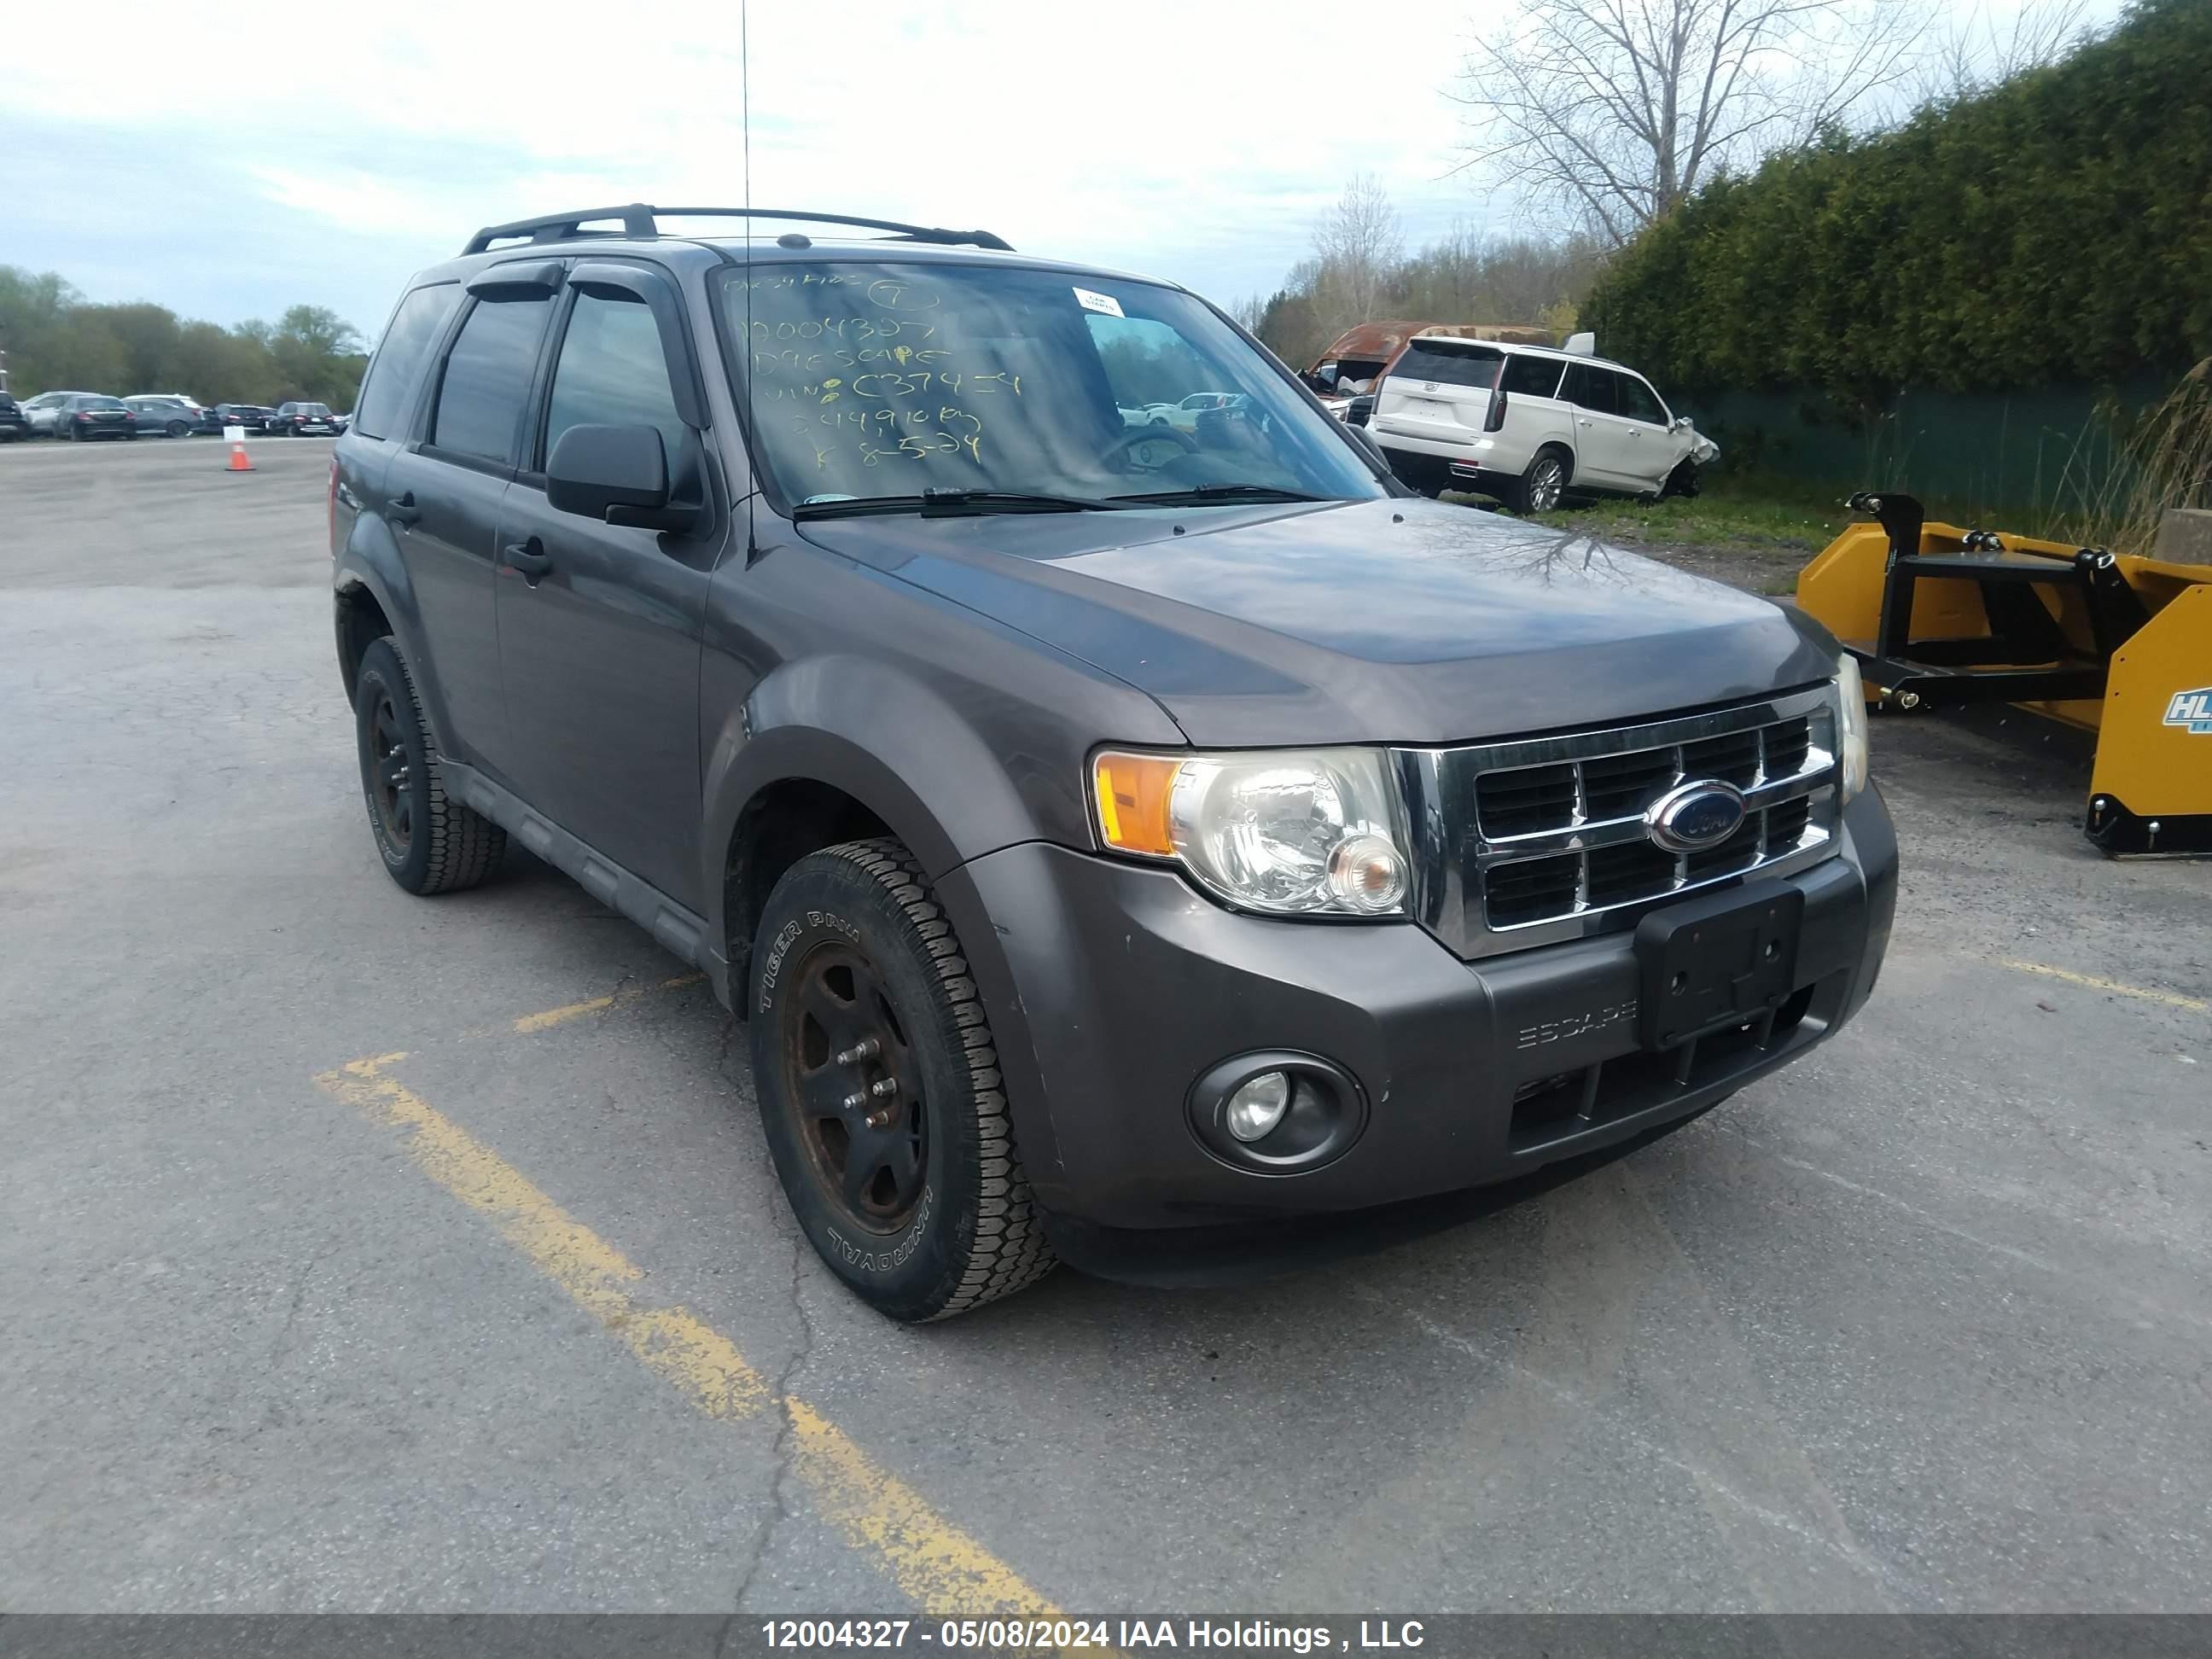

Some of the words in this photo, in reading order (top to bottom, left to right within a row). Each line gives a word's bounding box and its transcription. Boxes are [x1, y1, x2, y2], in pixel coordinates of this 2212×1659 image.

[757, 920, 803, 1014] TIGER
[1516, 998, 1638, 1050] ESCAPE
[826, 1185, 934, 1272] UNIROYAL
